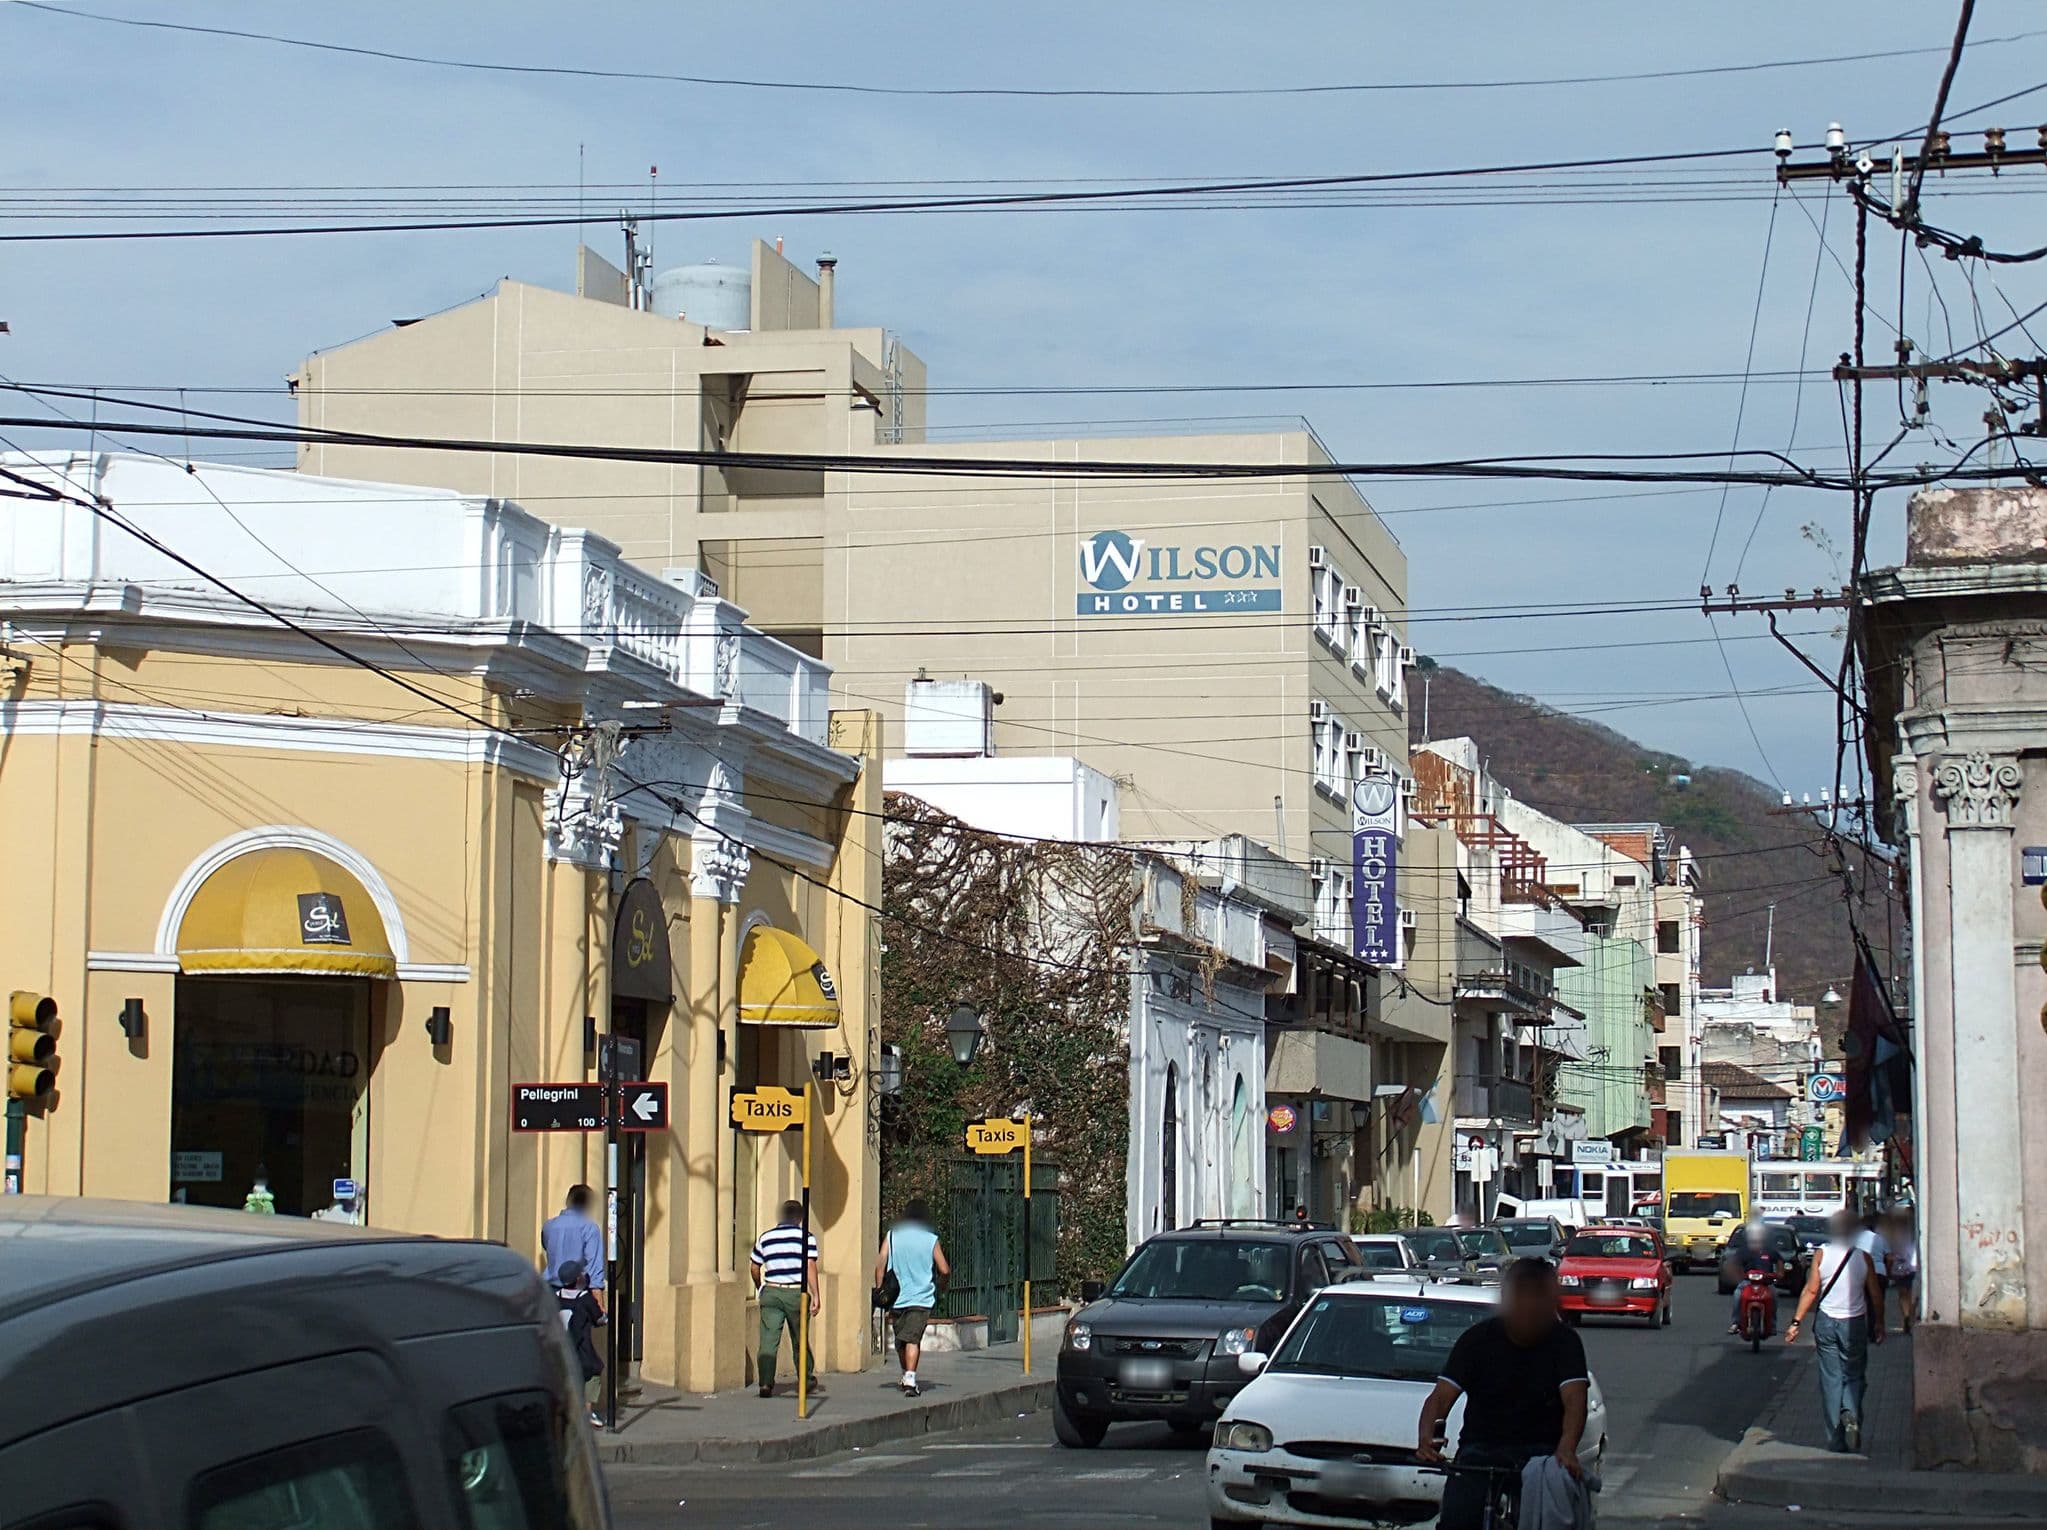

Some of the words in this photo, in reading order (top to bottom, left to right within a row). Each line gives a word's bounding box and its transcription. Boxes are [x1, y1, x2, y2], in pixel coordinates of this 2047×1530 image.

[1079, 538, 1281, 583] WILSON
[1094, 594, 1208, 612] HOTEL
[1356, 815, 1392, 827] WILSON
[1361, 836, 1388, 948] HOTEL
[520, 1088, 579, 1102] Pellegrini
[743, 1099, 793, 1118] Taxis
[520, 1118, 528, 1127] 0
[577, 1118, 596, 1127] 100
[975, 1127, 1016, 1143] Taxis
[1576, 1145, 1609, 1154] NOKIA
